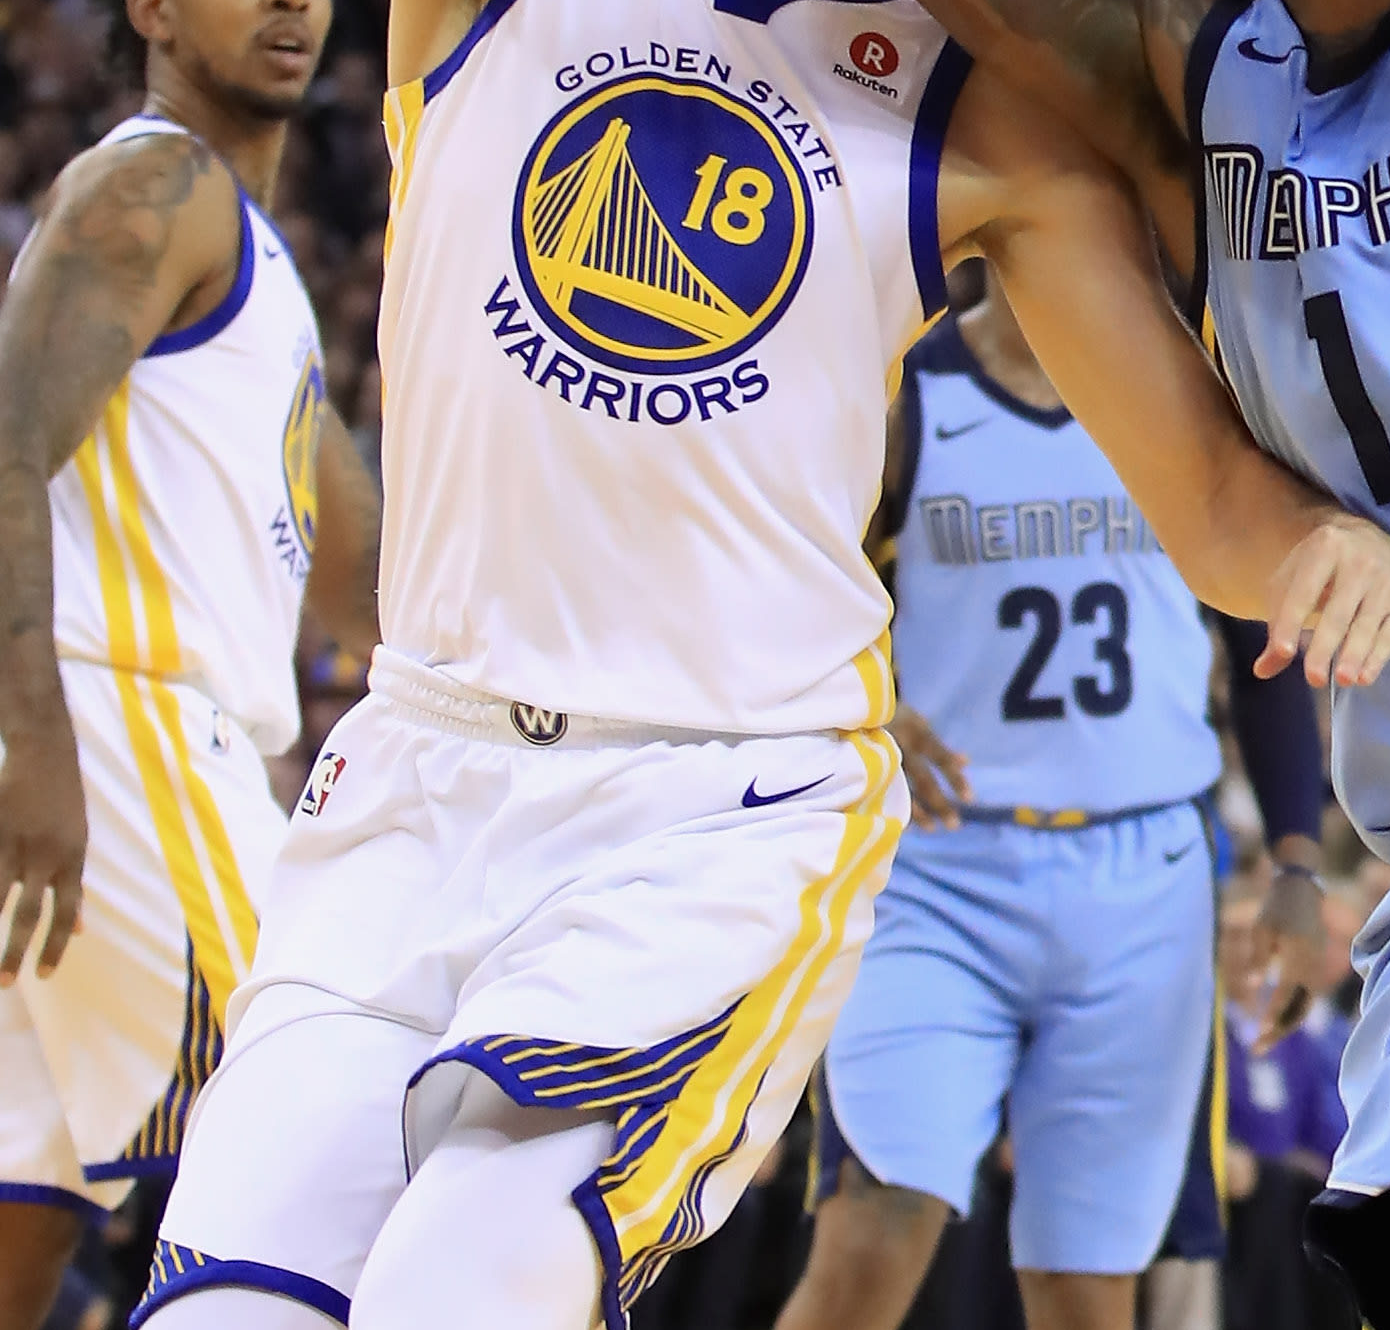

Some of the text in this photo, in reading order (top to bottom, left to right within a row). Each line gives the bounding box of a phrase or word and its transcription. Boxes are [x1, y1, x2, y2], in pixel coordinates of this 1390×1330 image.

[555, 42, 843, 192] GOLDEN STATE
[833, 63, 898, 99] Rakuten
[681, 154, 775, 246] 18
[484, 275, 770, 425] WARRIORS
[919, 494, 1165, 566] MEMPHI
[997, 581, 1133, 722] 23
